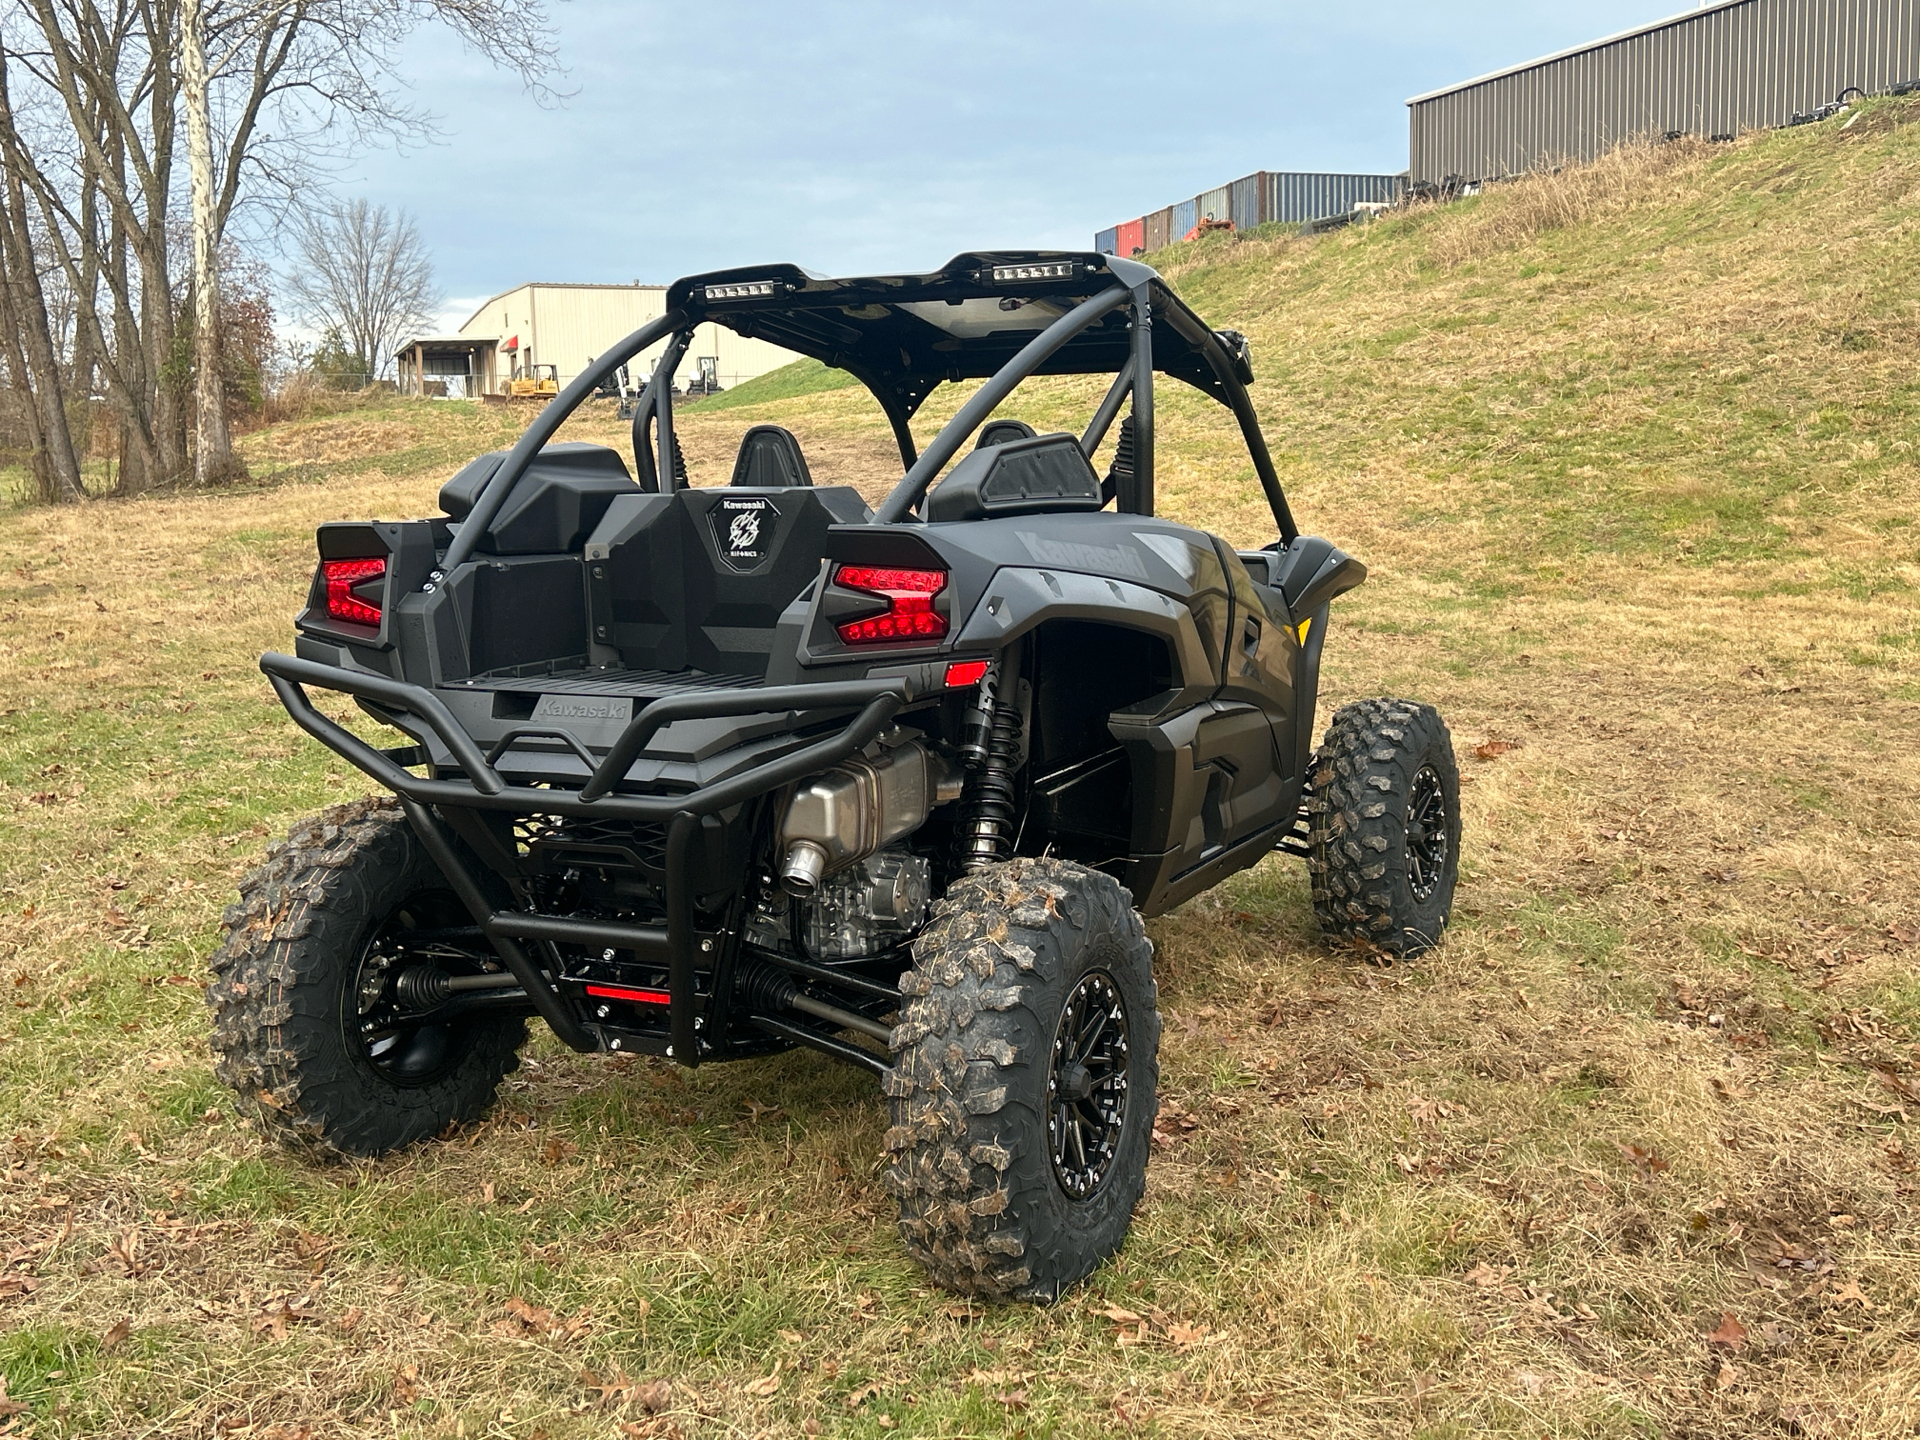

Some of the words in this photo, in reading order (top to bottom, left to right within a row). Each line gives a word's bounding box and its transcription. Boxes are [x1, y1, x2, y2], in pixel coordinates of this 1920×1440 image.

[723, 500, 765, 509] Kawasaki
[1013, 530, 1150, 580] Kawasaki
[538, 700, 628, 720] Kawasaki
